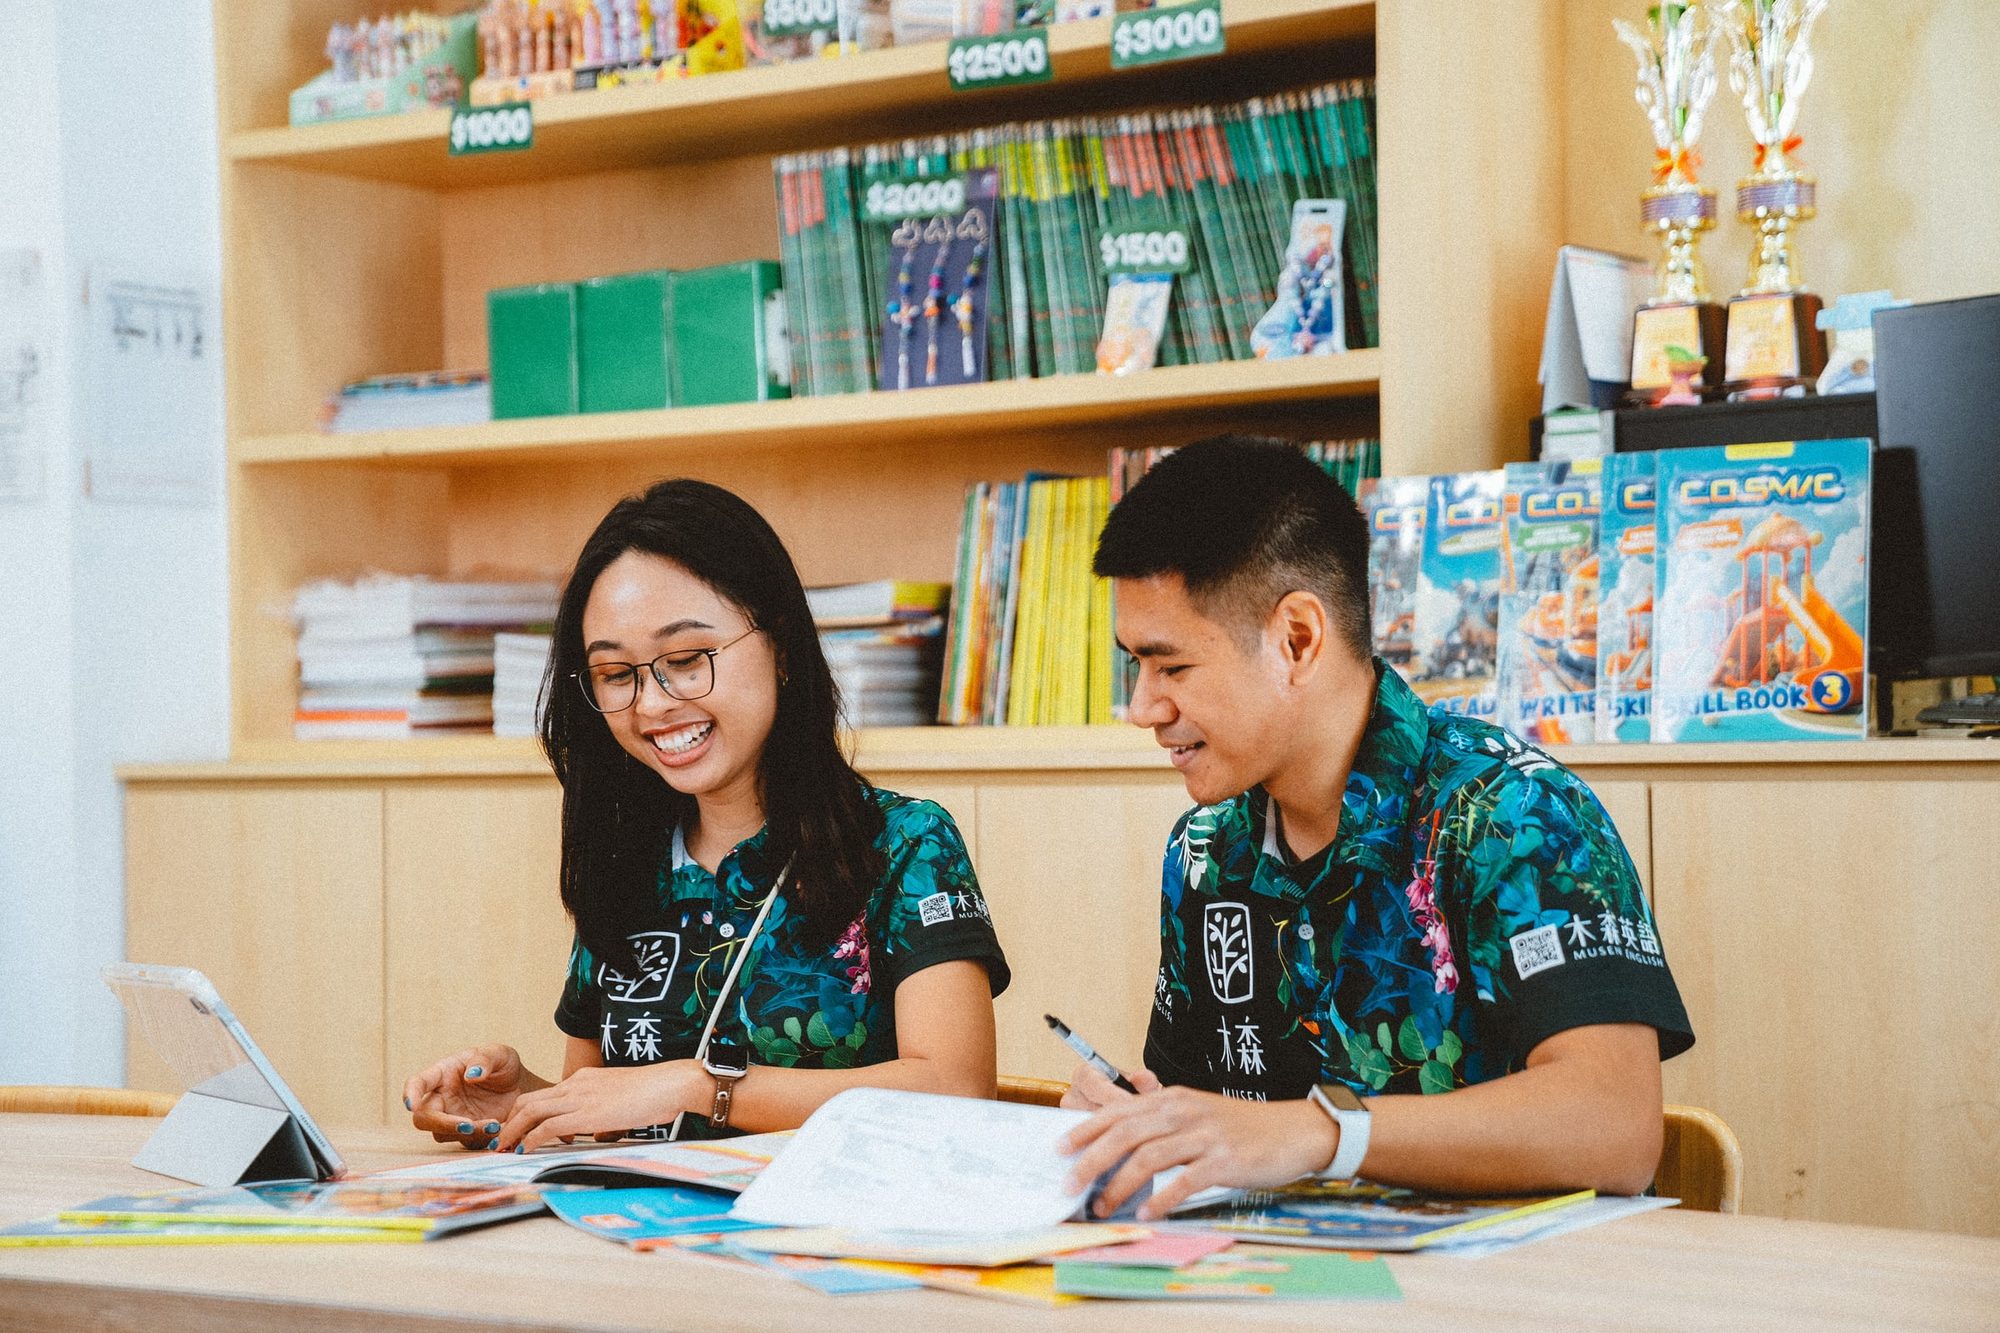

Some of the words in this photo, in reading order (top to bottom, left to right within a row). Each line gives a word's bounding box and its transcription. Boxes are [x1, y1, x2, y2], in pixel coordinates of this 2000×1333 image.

[1114, 8, 1220, 59] $3000
[948, 37, 1047, 83] $2500
[452, 107, 533, 151] $1000
[866, 178, 965, 216] $2000
[1101, 231, 1188, 267] $1500
[1680, 472, 1842, 505] COSMIC
[1607, 694, 1651, 718] SKI
[1735, 685, 1806, 710] BOOK
[1821, 675, 1842, 706] 3
[1573, 945, 1623, 960] MUSEN
[601, 1010, 663, 1061] 木森
[1216, 1015, 1267, 1075] 木森
